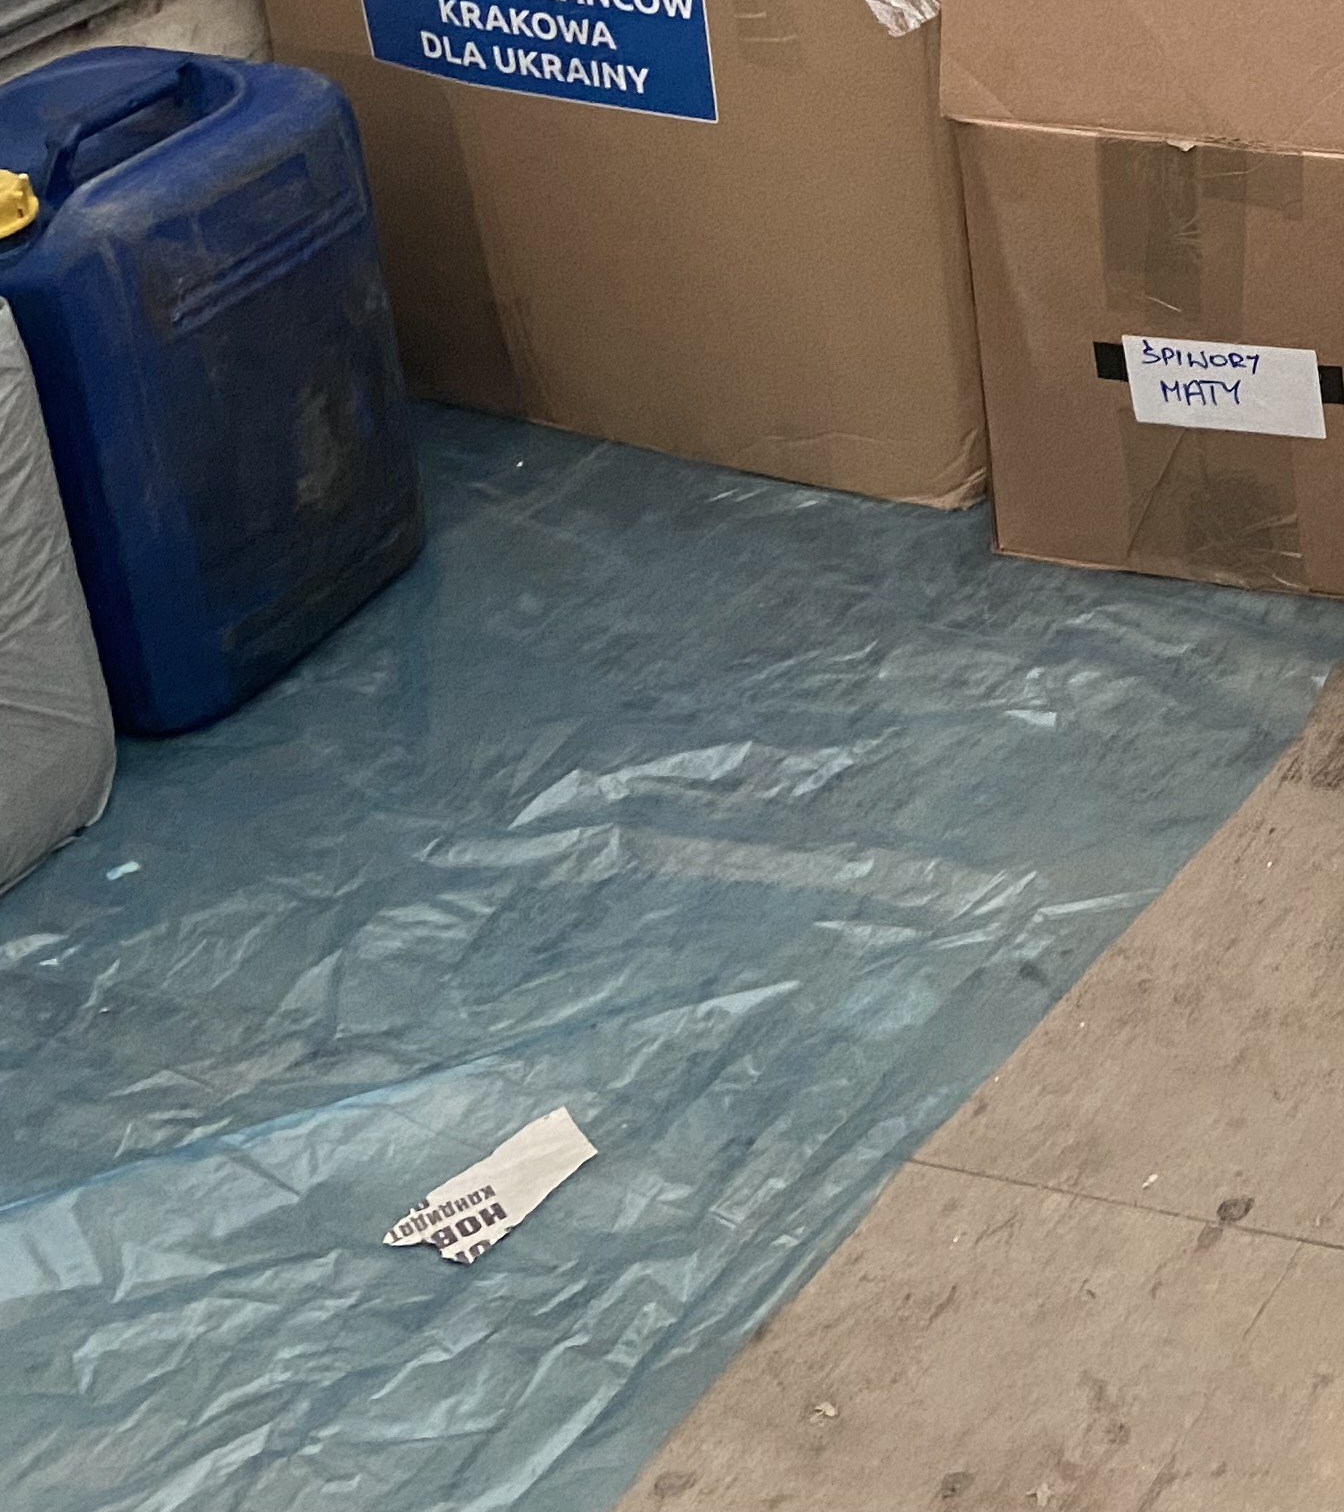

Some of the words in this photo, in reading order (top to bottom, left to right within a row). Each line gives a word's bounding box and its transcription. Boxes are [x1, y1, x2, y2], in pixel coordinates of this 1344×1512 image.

[420, 30, 487, 70] DLA
[493, 45, 649, 95] UKRAINY
[1159, 378, 1242, 406] MATY
